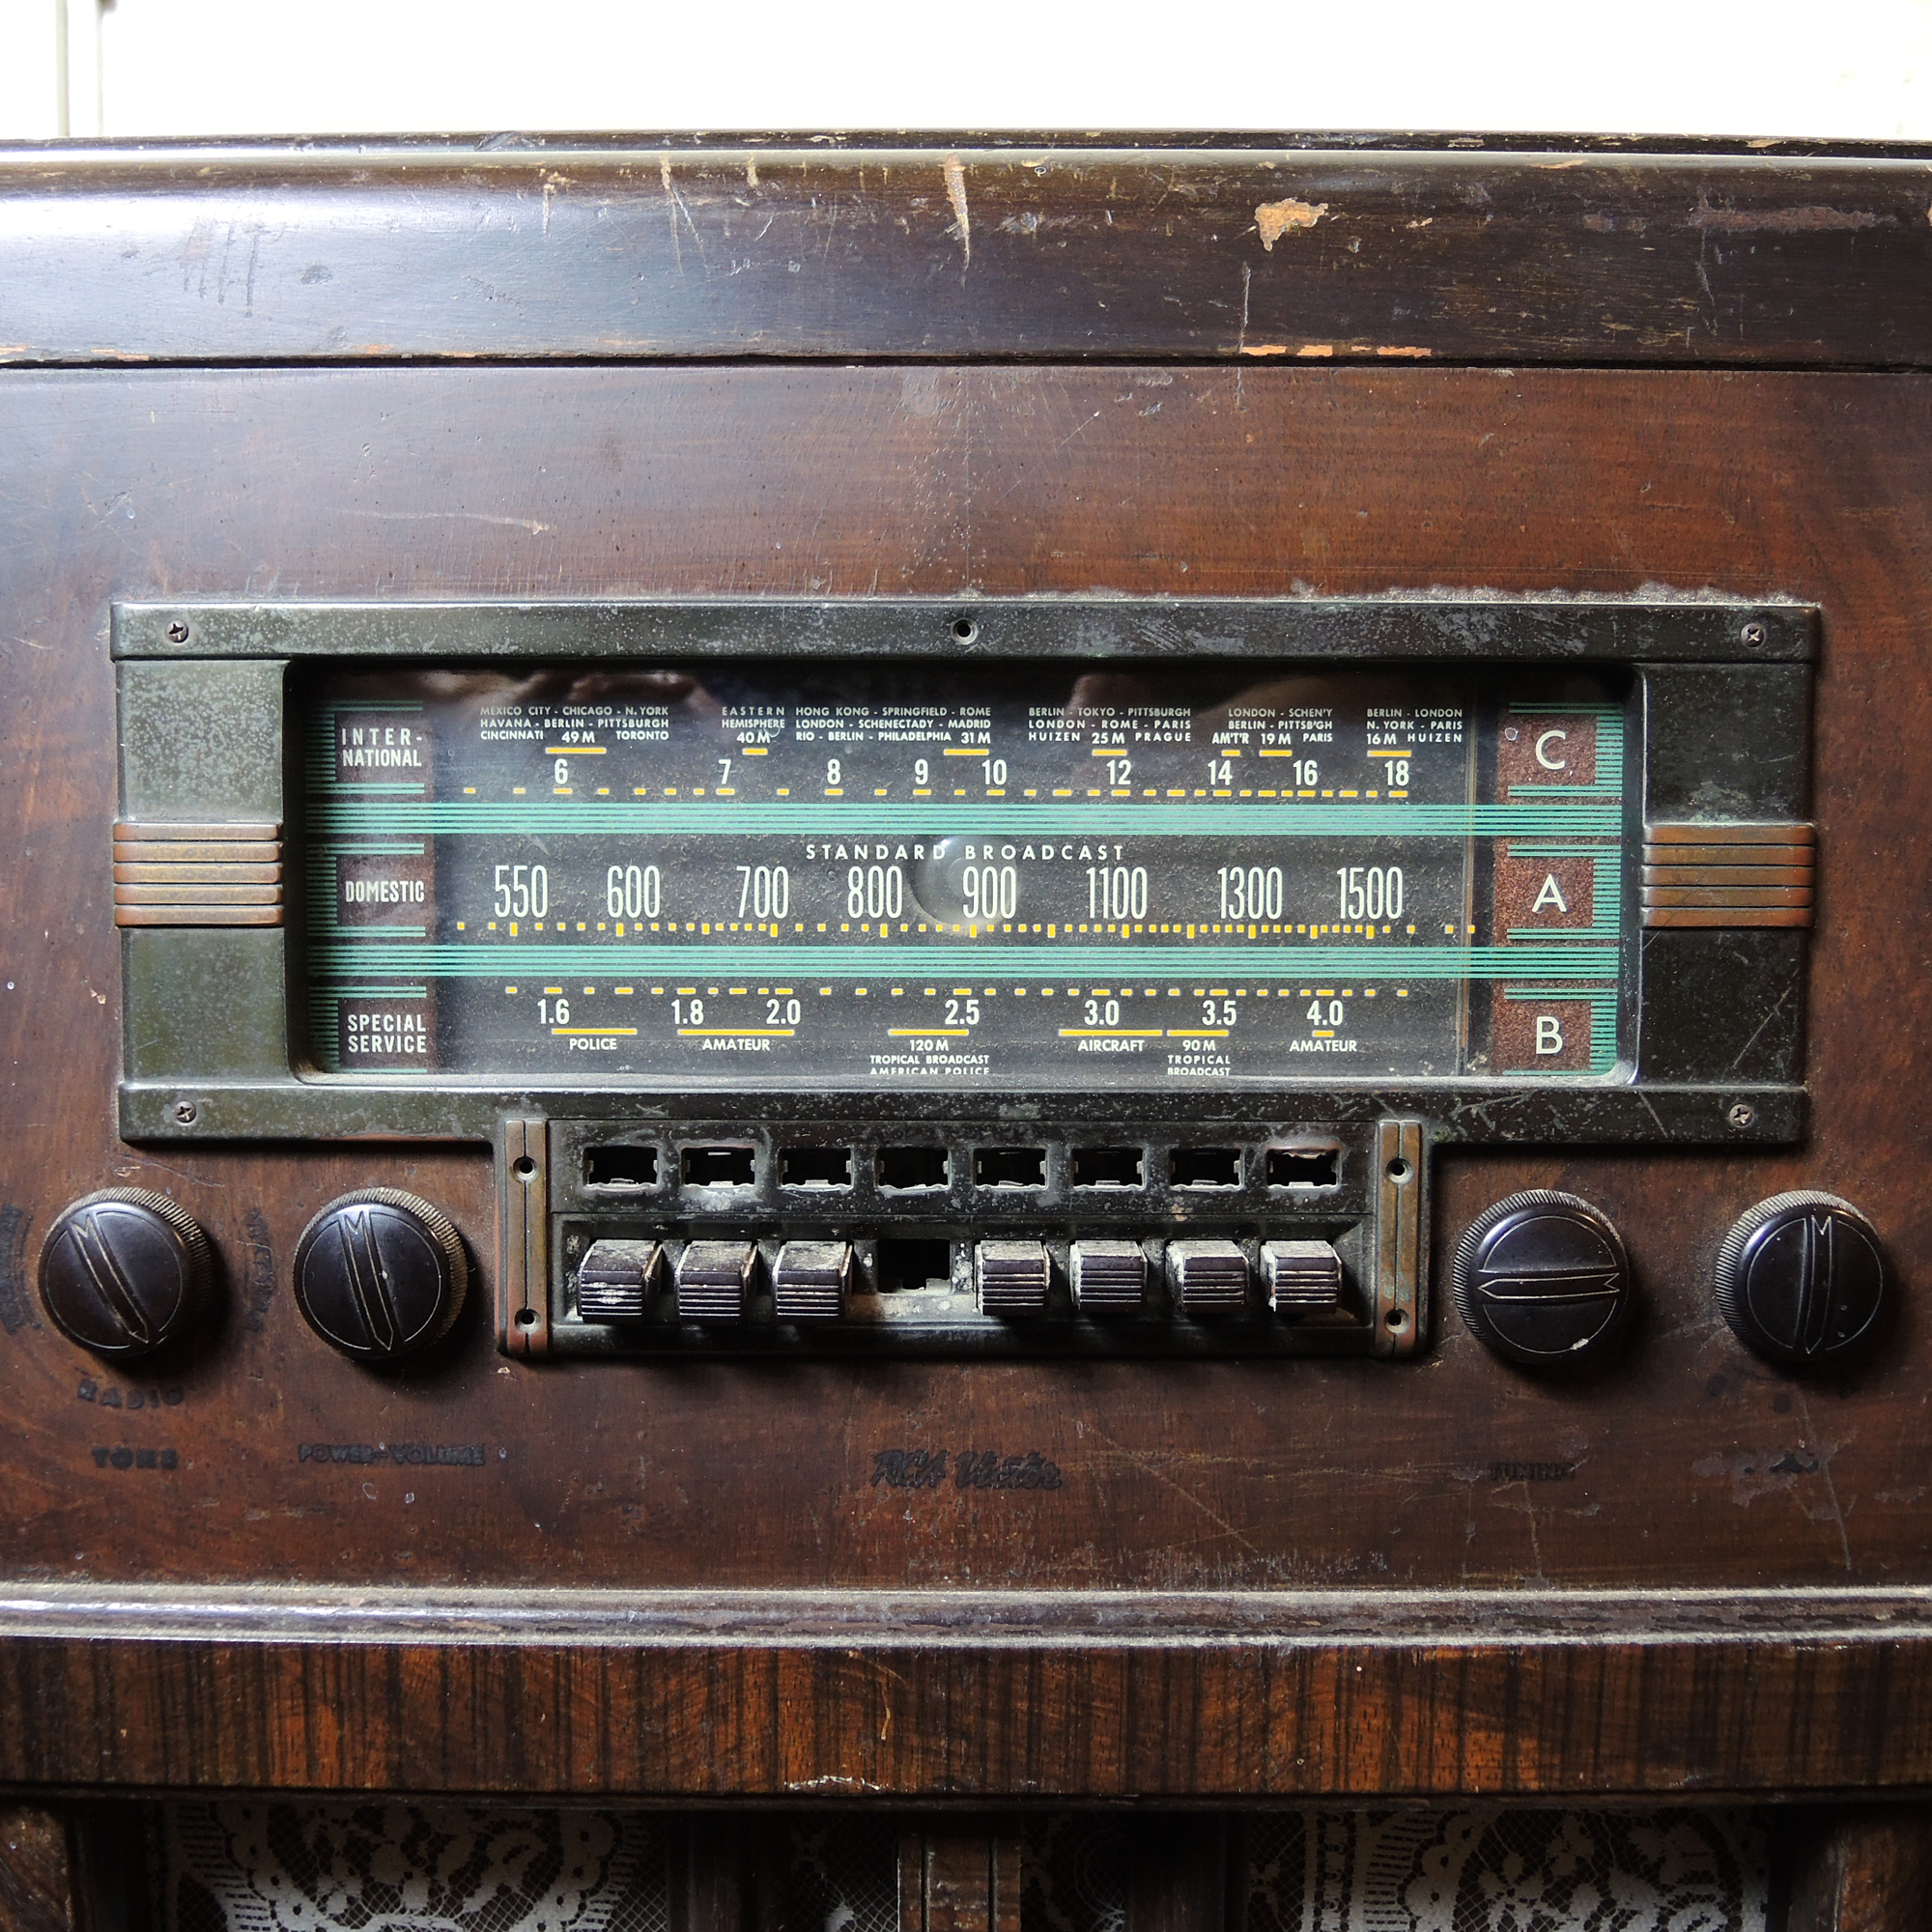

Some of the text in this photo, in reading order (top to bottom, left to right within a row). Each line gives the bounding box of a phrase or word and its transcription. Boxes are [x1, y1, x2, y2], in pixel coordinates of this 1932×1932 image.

[480, 706, 522, 716] MEXICO
[722, 707, 784, 716] EASTERN
[796, 707, 990, 716] HONG KONG SPRINGFIELD ROME
[1075, 706, 1115, 716] TOKYO
[1128, 708, 1190, 717] PITTSBURGH
[1229, 708, 1332, 717] LONDON SCHEN'Y
[481, 719, 668, 727] HAVANA BERLIN PITTSBURGH
[722, 719, 784, 728] HEMISPHERE
[796, 720, 990, 728] LONDON SCHENECTADY MADRID
[1029, 720, 1190, 729] LONDON ROME PARIS
[1229, 721, 1332, 729] BERLIN PITTSB'GH
[1367, 721, 1462, 729] N. YORK PARIS
[343, 728, 422, 746] INTER-
[481, 730, 543, 740] CINCINNATI
[562, 731, 595, 743] 49 M
[616, 730, 668, 740] TORONTO
[737, 731, 770, 744] 40 M
[796, 731, 952, 741] RIO BERLIN PHILADELPHIA
[961, 732, 990, 744] 31 M
[1029, 732, 1080, 741] HUIZEN
[1092, 732, 1124, 744] 25 M
[1136, 732, 1190, 741] PRAGUE
[1212, 732, 1249, 744] AM'T'R
[1262, 733, 1291, 745] 19 M
[1303, 733, 1332, 742] PARIS
[1367, 733, 1396, 745] 16 M
[1407, 733, 1462, 742] HUIZEN
[1536, 730, 1565, 769] C
[343, 750, 421, 766] NATIONAL
[554, 758, 1408, 785] 6 7 8 9 10 12 14 16 18
[807, 843, 1122, 860] STANDARD BROADCAST
[346, 880, 424, 902] DOMESTIC
[495, 865, 1403, 921] 550 600 700 800 900 1100 1300 1500
[1532, 874, 1567, 913] A
[538, 999, 1343, 1025] 1.6 1.8 2.0 2.5 3.0 3.5 4.0
[348, 1014, 426, 1032] SPECIAL
[1536, 1016, 1562, 1054] B
[349, 1036, 426, 1053] SERVICE
[570, 1038, 617, 1050] POLICE
[702, 1038, 770, 1051] AMATEUR
[910, 1039, 949, 1051] 120 M
[1078, 1039, 1145, 1052] AIRCRAFT
[1182, 1039, 1216, 1051] 90 M
[1290, 1040, 1357, 1051] AMATEUR
[870, 1055, 989, 1064] TROPICAL BROADCAST
[1168, 1055, 1230, 1065] TROPICAL
[1168, 1067, 1231, 1076] BROADCAST
